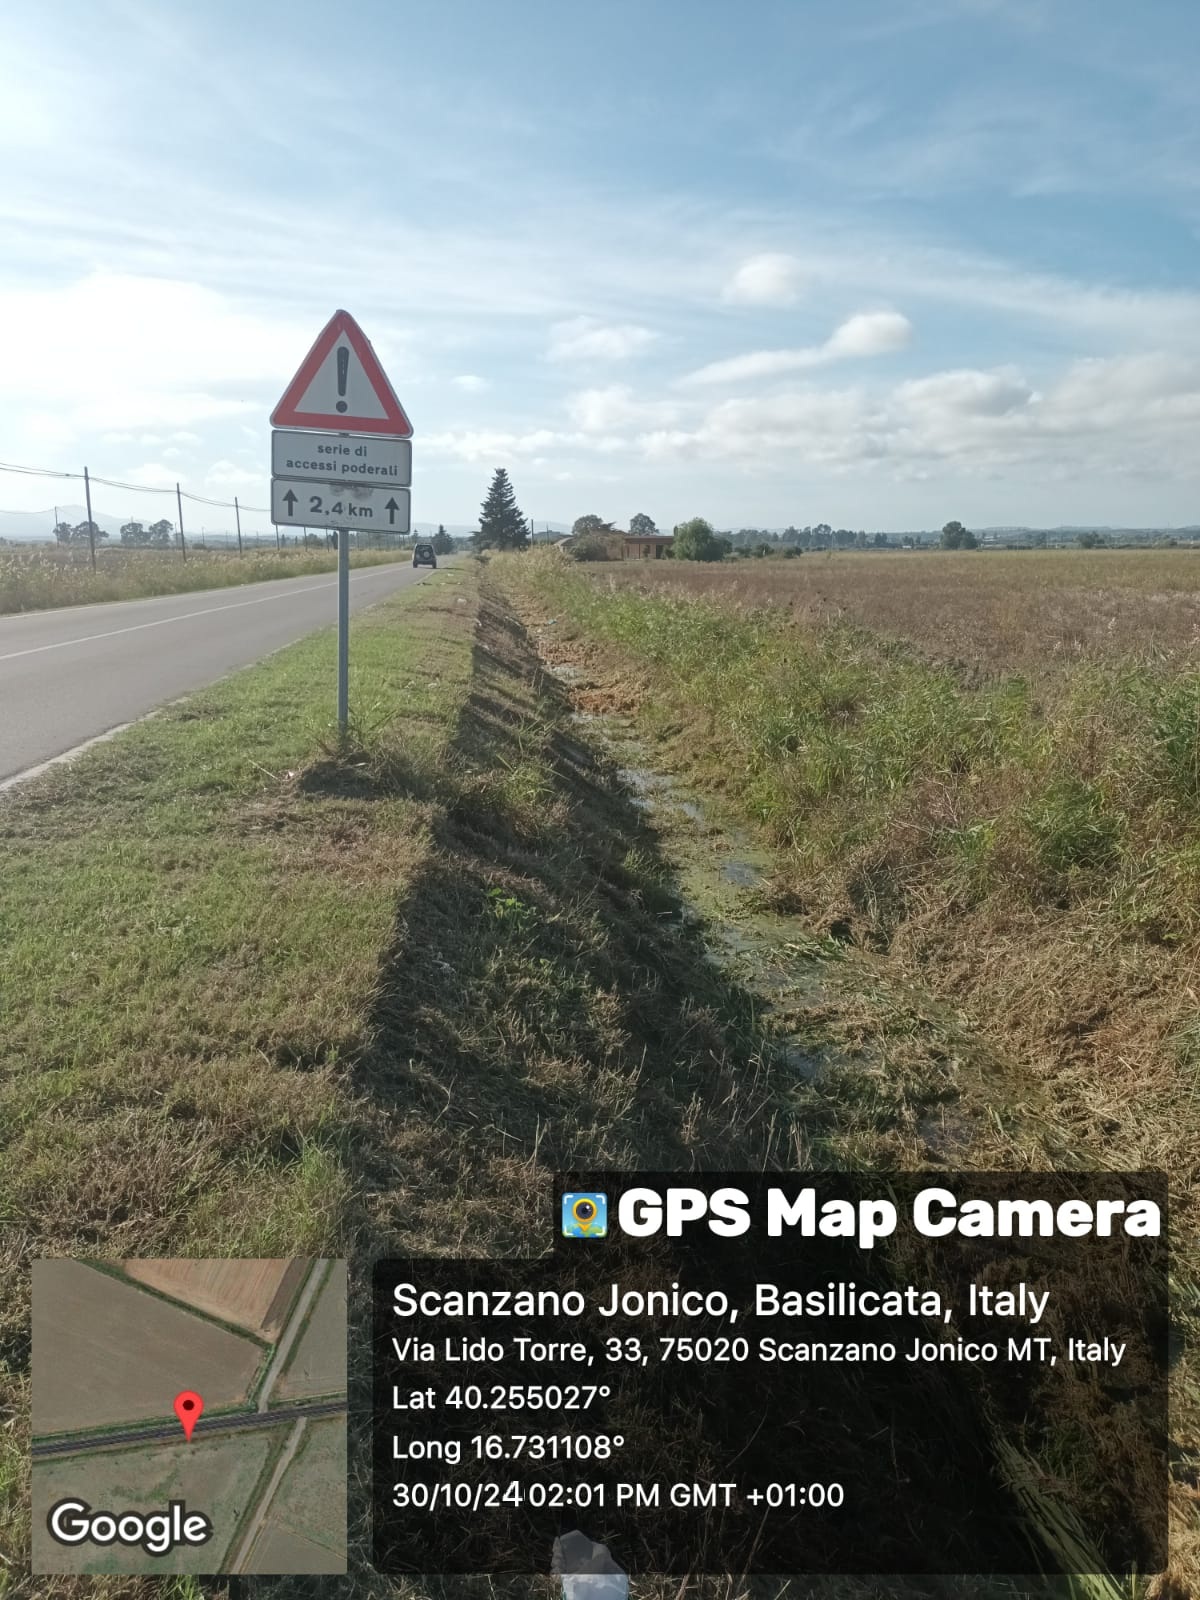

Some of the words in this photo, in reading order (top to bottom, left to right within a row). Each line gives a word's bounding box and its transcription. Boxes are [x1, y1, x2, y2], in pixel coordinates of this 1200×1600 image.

[317, 444, 350, 456] serie
[354, 445, 367, 457] di
[286, 459, 337, 472] accessi
[341, 463, 398, 476] poderali
[348, 502, 373, 518] km
